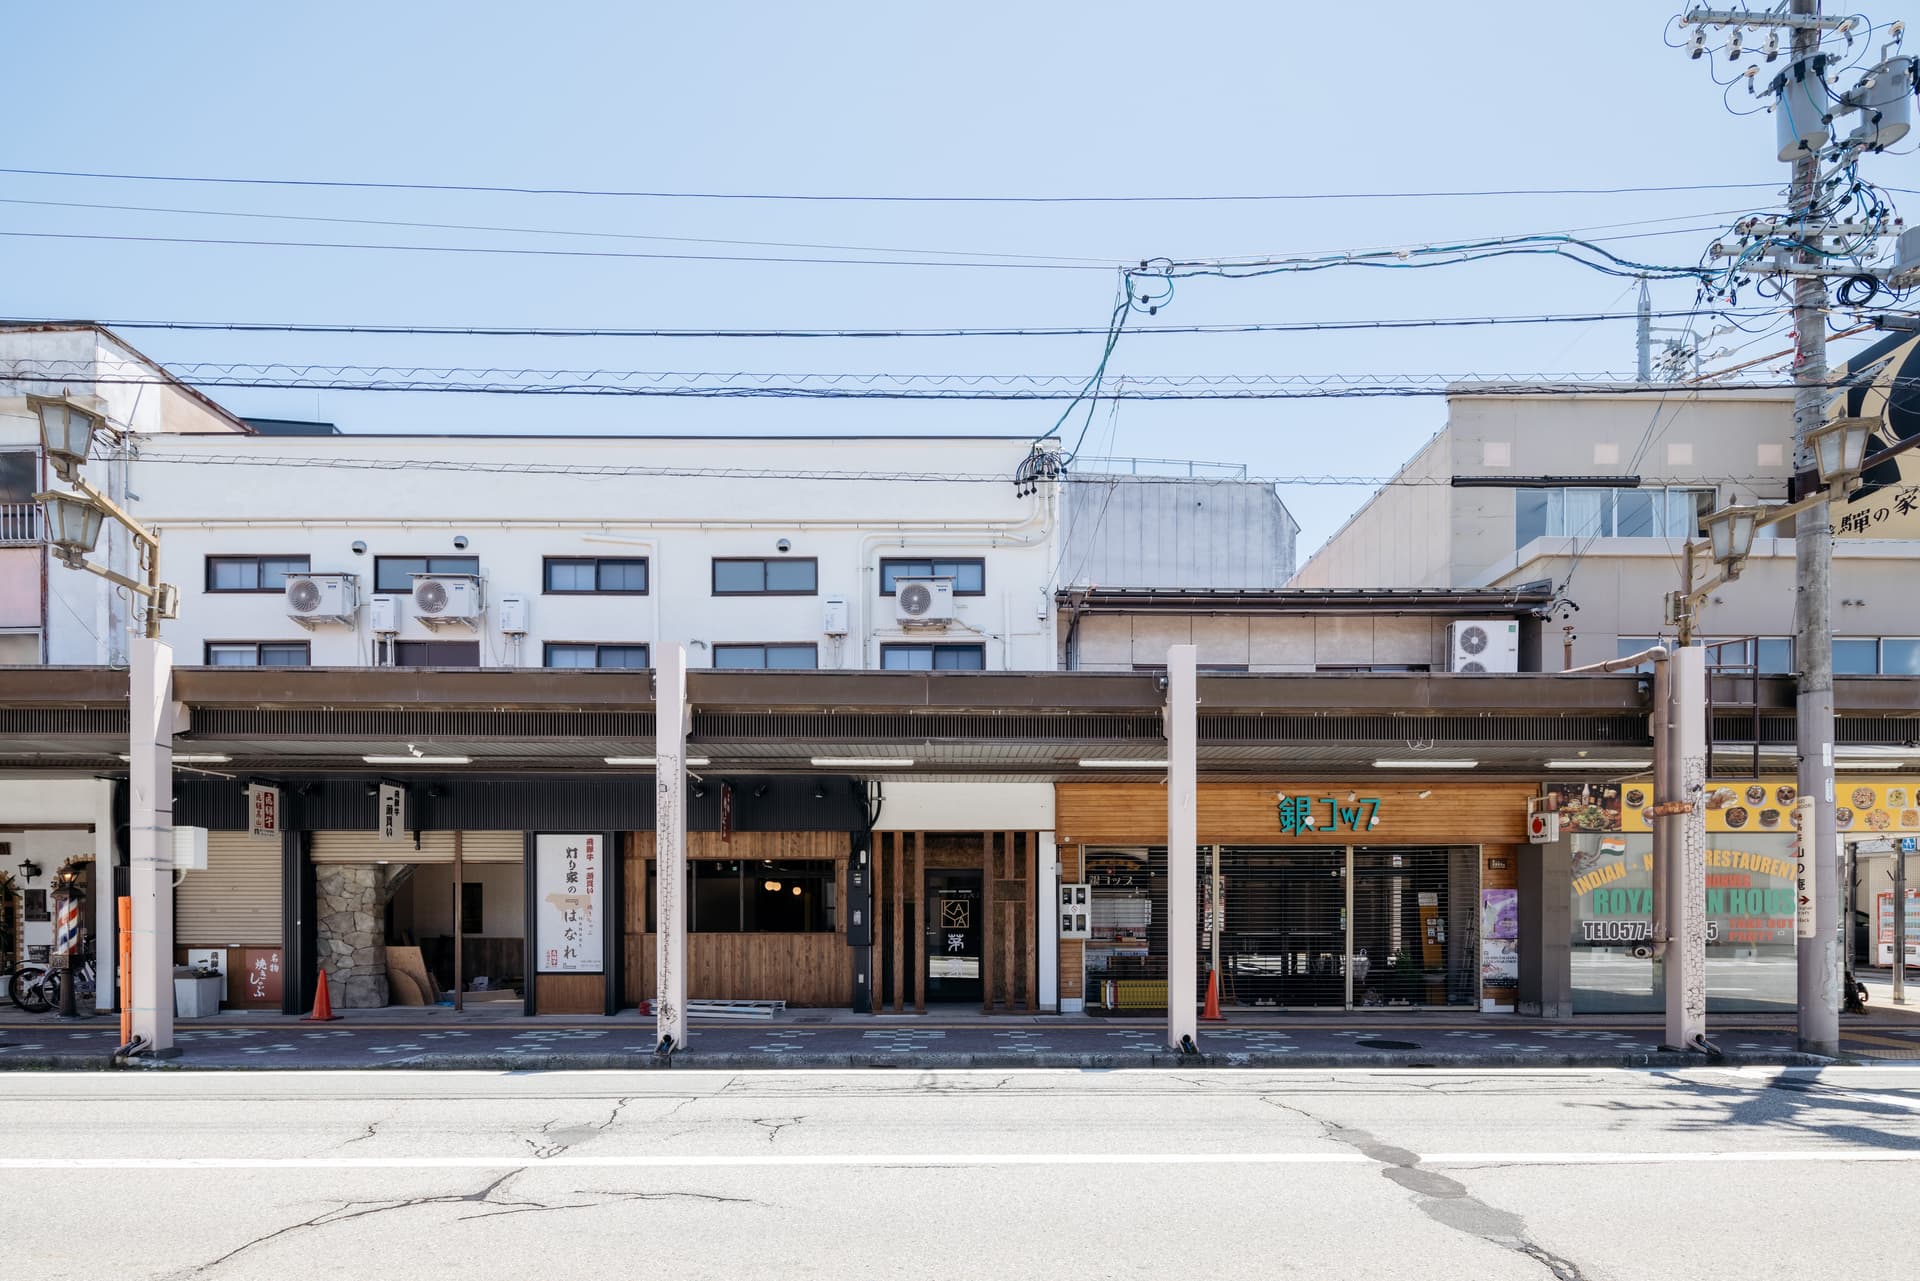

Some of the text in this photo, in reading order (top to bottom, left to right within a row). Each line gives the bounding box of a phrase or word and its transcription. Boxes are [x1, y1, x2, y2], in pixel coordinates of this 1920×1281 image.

[1572, 862, 1627, 896] INDIAN
[1593, 888, 1653, 916] ROYA
[1729, 888, 1797, 916] HOUS
